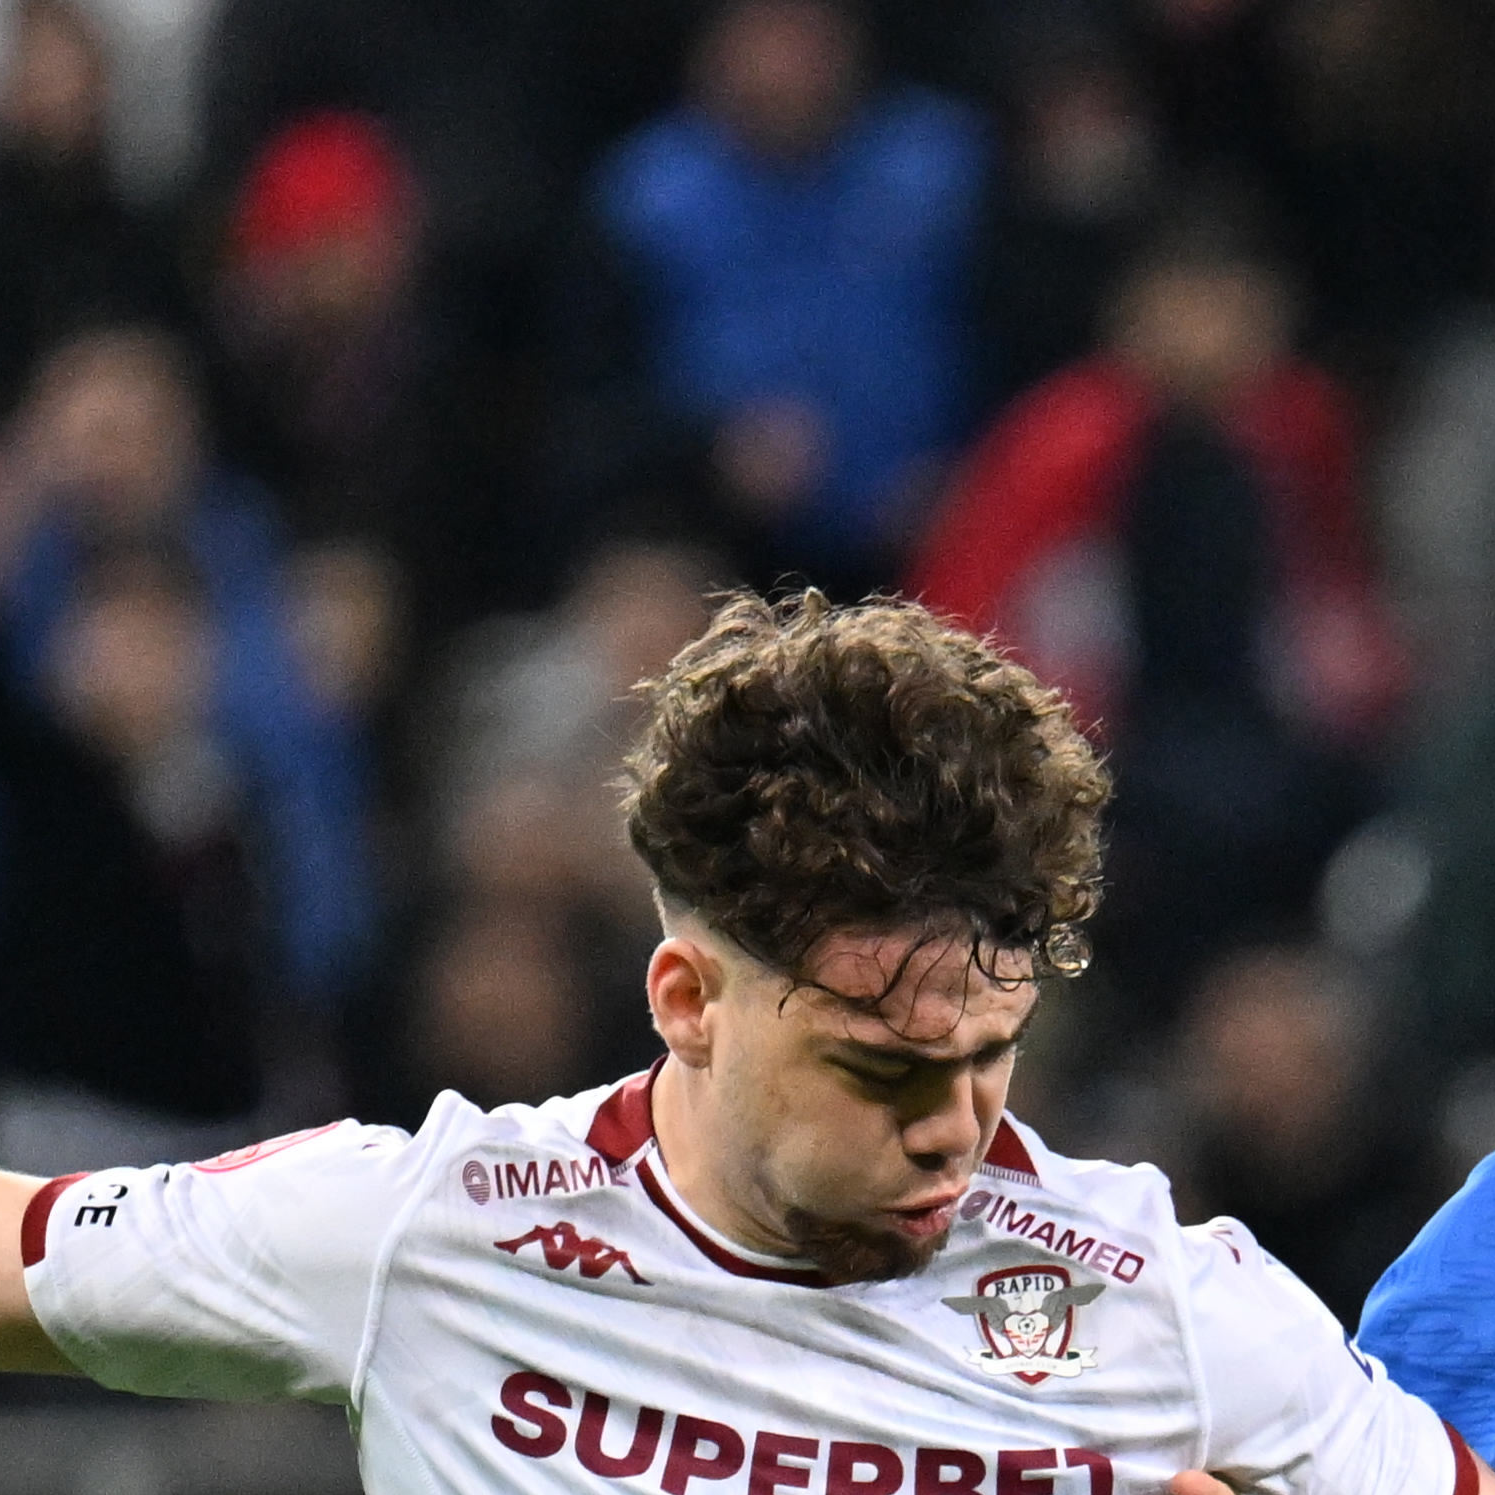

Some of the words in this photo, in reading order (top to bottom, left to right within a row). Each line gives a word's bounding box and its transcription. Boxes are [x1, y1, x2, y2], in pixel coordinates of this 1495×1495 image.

[494, 1156, 630, 1199] IMAM
[986, 1195, 1145, 1284] IMAMED
[994, 1276, 1056, 1298] RAPID
